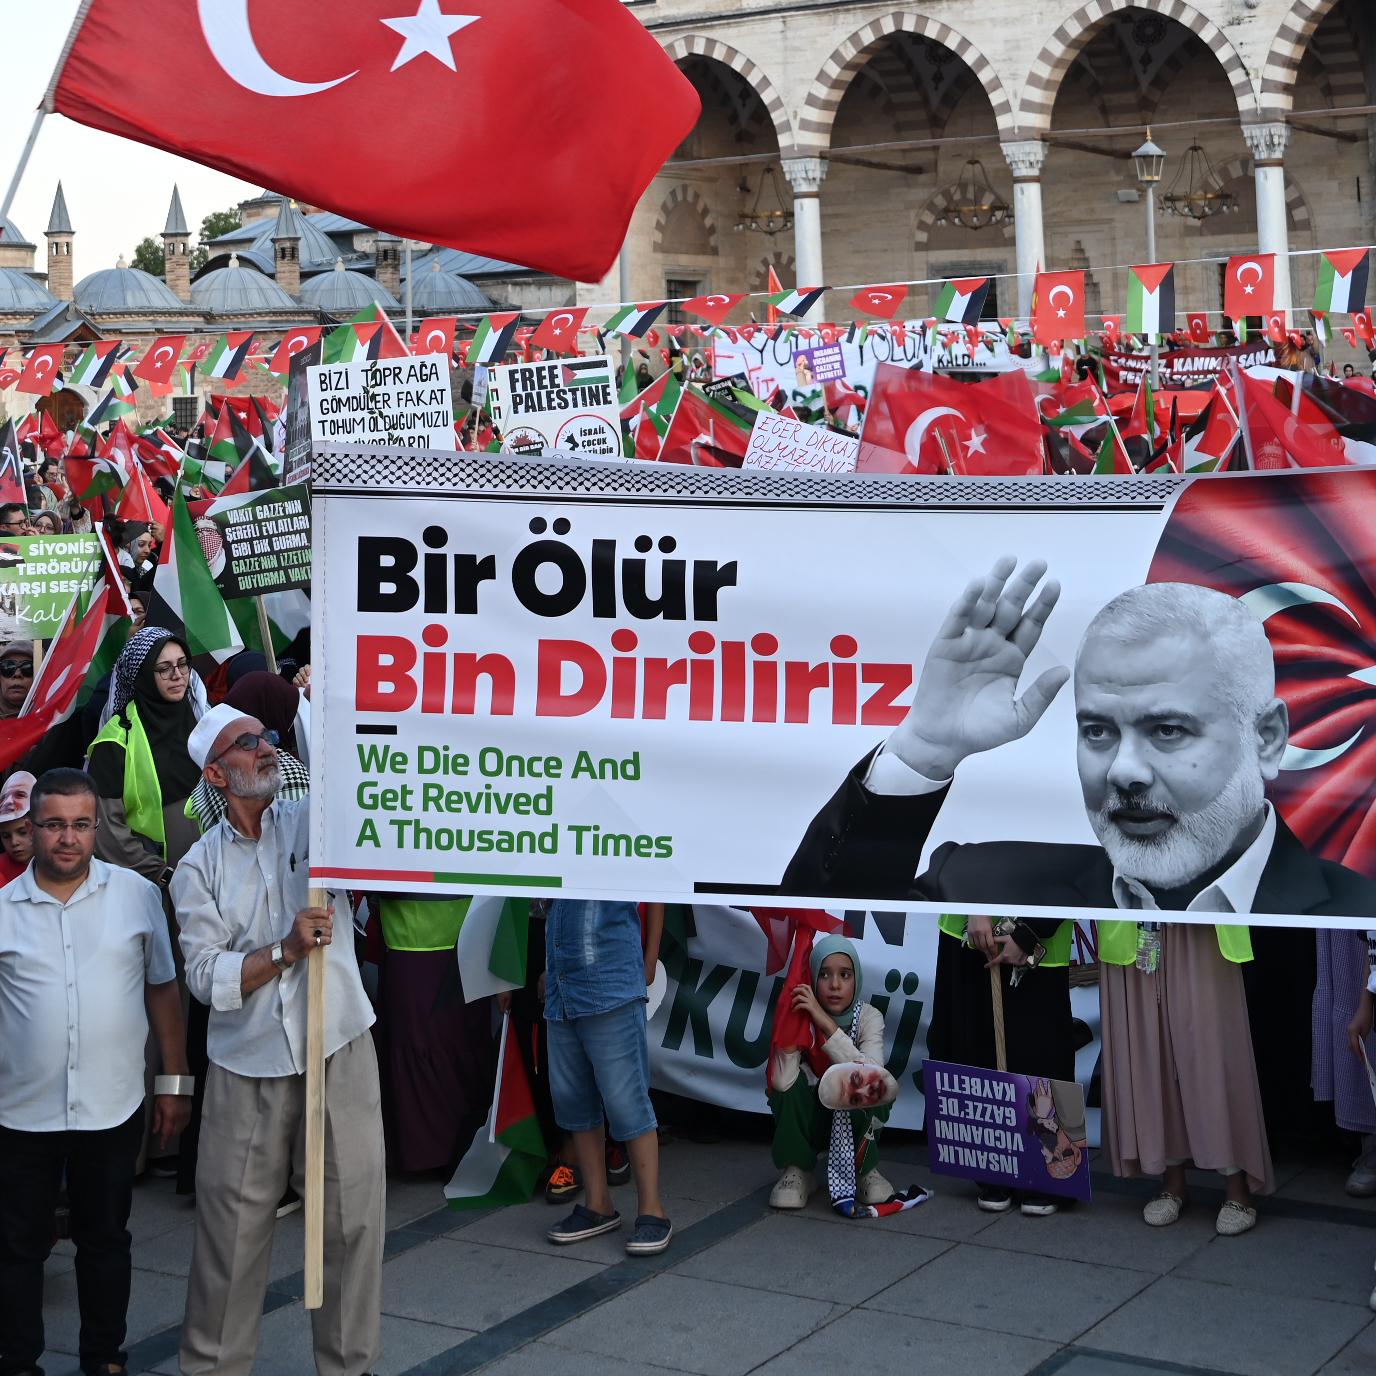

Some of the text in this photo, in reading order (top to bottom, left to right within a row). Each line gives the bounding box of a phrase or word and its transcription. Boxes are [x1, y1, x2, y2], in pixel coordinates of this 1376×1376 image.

[1238, 349, 1276, 367] SANA
[319, 361, 439, 392] BİZİ TOPRAĞA
[508, 364, 561, 393] FREE
[319, 388, 446, 416] GÖMDÜLER FAKAT
[511, 384, 613, 414] PALESTINE
[318, 410, 449, 437] TOHUM OLDUĞUMUZU
[580, 425, 606, 437] İSRAİL
[758, 417, 802, 443] EĞER
[581, 437, 607, 448] ÇOCUK
[226, 499, 303, 524] VAKİT GAZZE'NİN
[225, 515, 310, 543] ŞEREFLİ EVLATLARI
[29, 538, 101, 557] SİYONİST
[231, 542, 252, 558] GİBİ
[253, 539, 271, 555] DİK
[231, 548, 312, 575] GAZZE'NİN İZZETİN
[238, 565, 312, 590] DUYURMA VAKT
[357, 516, 738, 622] Bir Ölür
[49, 576, 97, 594] SESSİ
[355, 624, 913, 726] Bin Diriliriz
[356, 743, 641, 781] We Die Once And
[356, 781, 553, 816] Get Revived
[355, 818, 673, 858] A Thousand Times
[935, 1071, 1017, 1103] KAYBETTİ
[939, 1096, 1017, 1127] GAZZE'DE
[934, 1119, 1025, 1154] VİCDANINI
[937, 1144, 1019, 1179] İNSANLIK
